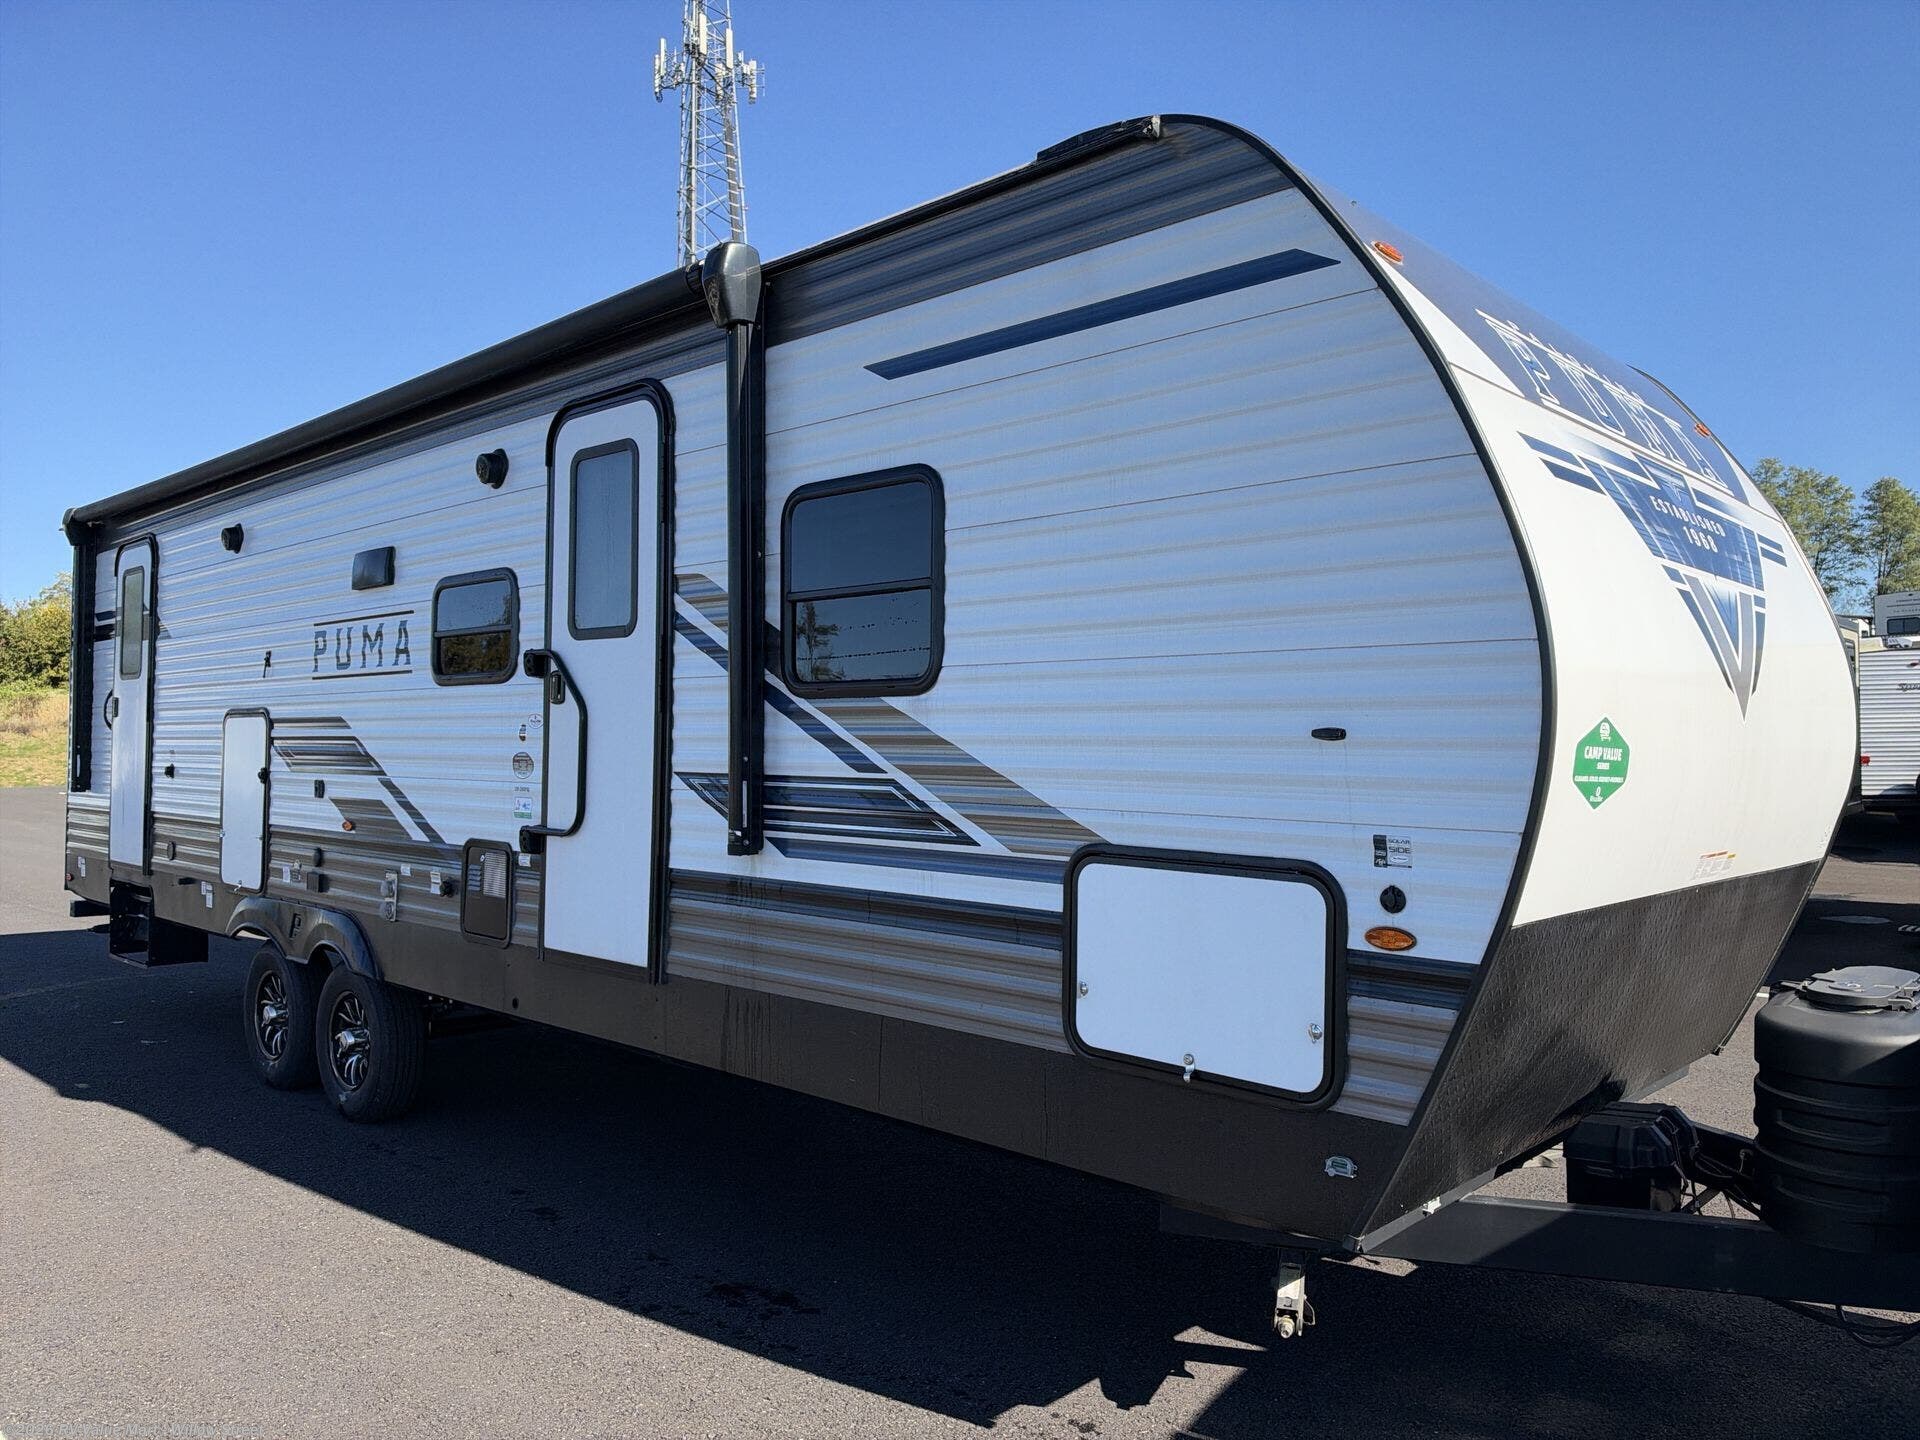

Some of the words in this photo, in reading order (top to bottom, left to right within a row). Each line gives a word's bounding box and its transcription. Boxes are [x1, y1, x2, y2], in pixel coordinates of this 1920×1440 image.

[1485, 318, 1729, 489] PUMA
[1649, 495, 1726, 537] ESTABLISHED
[1683, 526, 1718, 553] 1968
[312, 619, 411, 672] PUMA
[1584, 745, 1602, 760] CAMP
[1603, 747, 1622, 761] VALUE
[1388, 846, 1411, 854] SIDE
